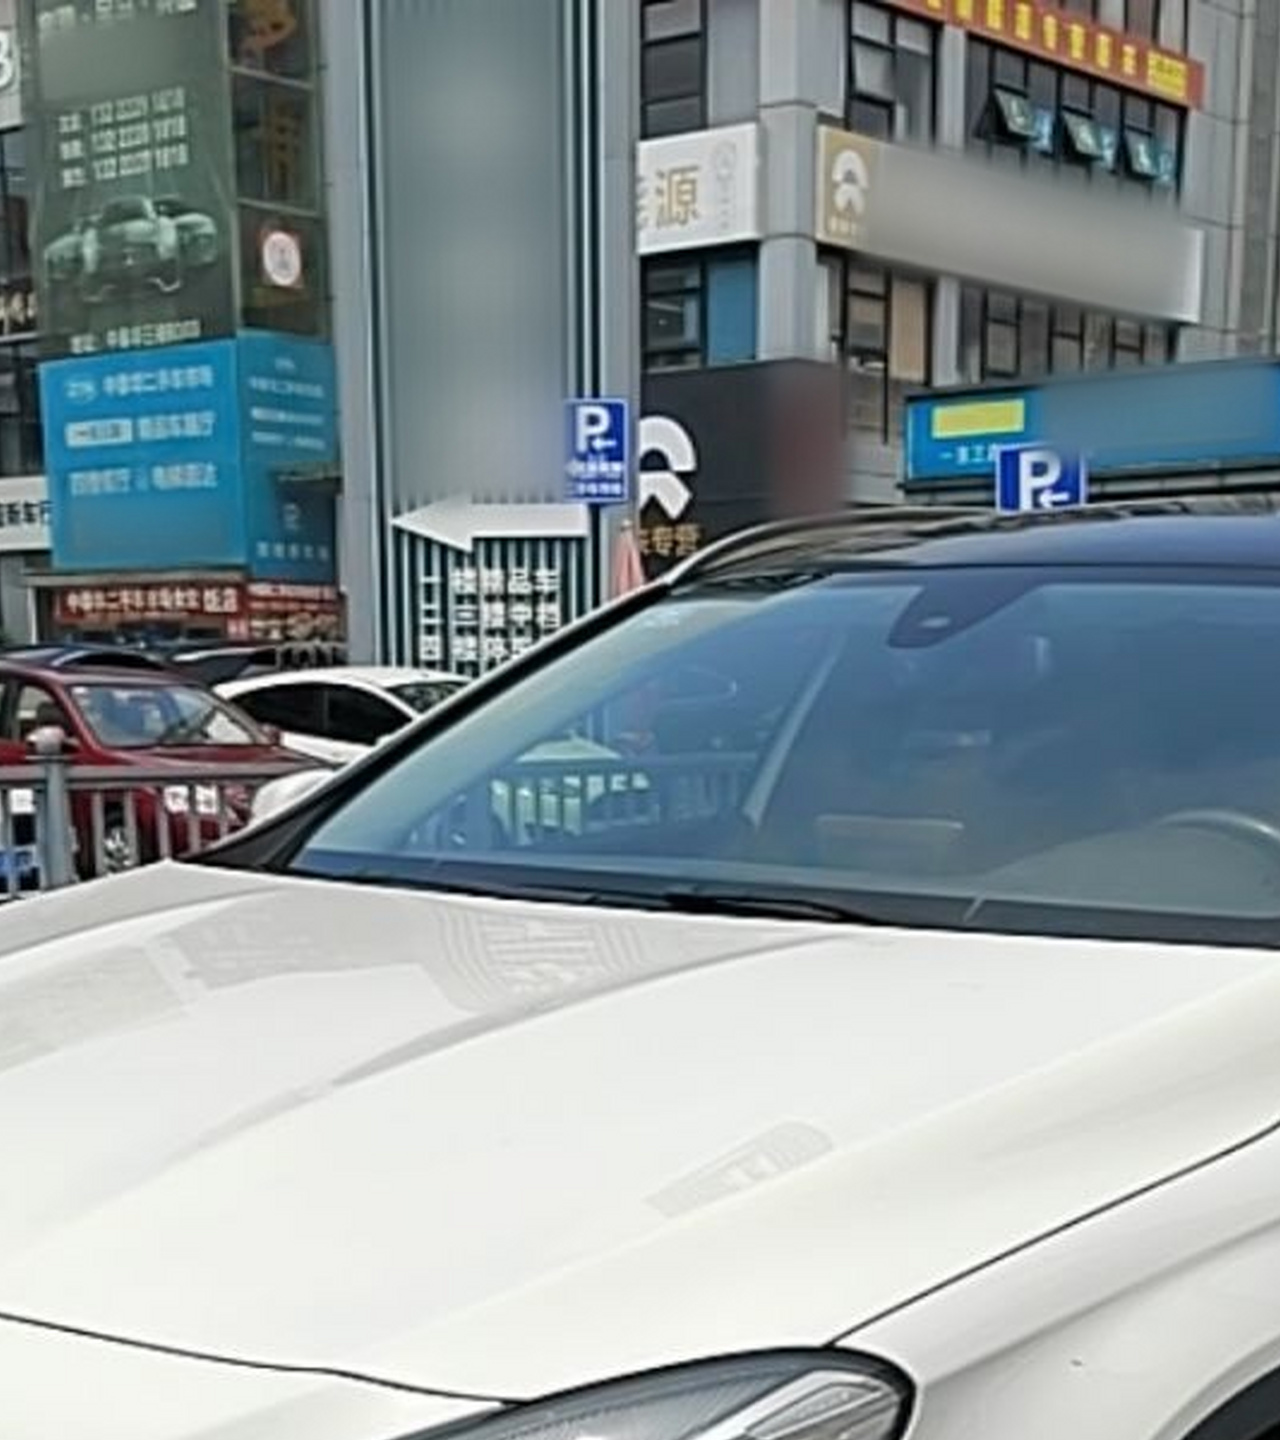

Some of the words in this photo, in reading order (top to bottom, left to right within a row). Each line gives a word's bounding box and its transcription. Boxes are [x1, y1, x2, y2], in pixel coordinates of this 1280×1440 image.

[636, 165, 702, 231] 源
[576, 405, 611, 453] P
[1020, 450, 1062, 511] P
